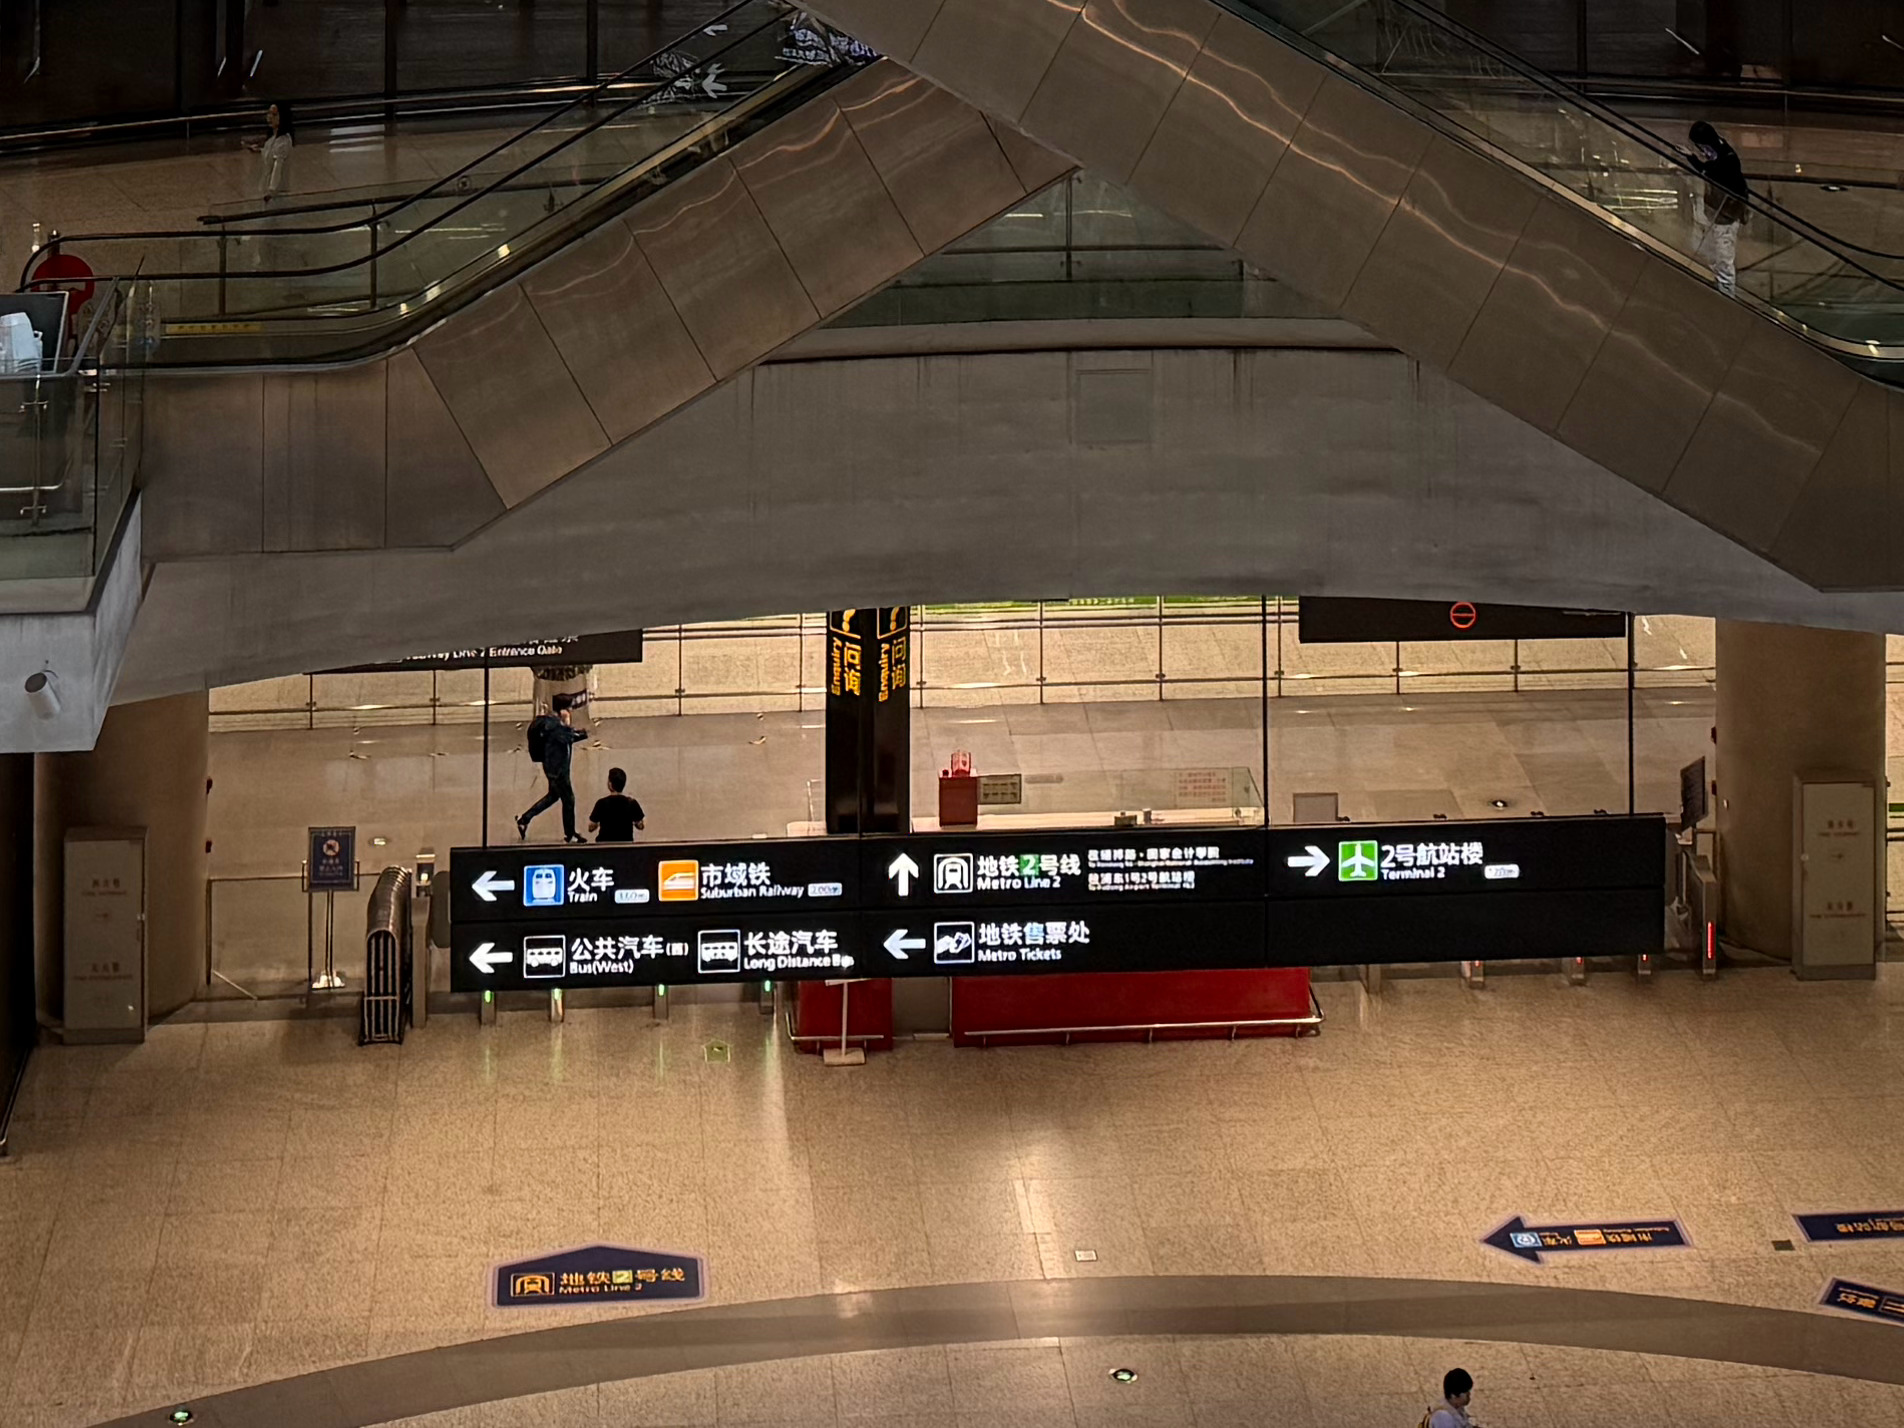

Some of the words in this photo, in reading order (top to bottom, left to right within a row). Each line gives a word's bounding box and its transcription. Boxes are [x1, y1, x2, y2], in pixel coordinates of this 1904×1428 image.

[1380, 842, 1484, 868] 2号航站楼
[976, 854, 1082, 877] 地铁2号线
[1381, 867, 1435, 880] Terminal
[1437, 867, 1446, 879] 2
[568, 866, 615, 892] 火车
[700, 862, 771, 887] 市域铁
[977, 876, 1022, 891] Metro
[1024, 875, 1050, 889] Line
[1052, 875, 1062, 889] 2
[568, 890, 598, 903] Train
[700, 885, 757, 900] Suburban
[759, 884, 805, 900] Railway
[978, 920, 1090, 946] 地铁售票处
[743, 929, 839, 955] 长途汽车
[743, 956, 776, 972] Long
[776, 955, 832, 969] Distance
[978, 948, 1017, 962] Metro
[1019, 948, 1063, 961] Tickets
[569, 959, 635, 975] Bus(West)
[559, 1266, 686, 1286] 地铁2号线
[559, 1284, 600, 1295] Metro
[603, 1284, 632, 1293] Line
